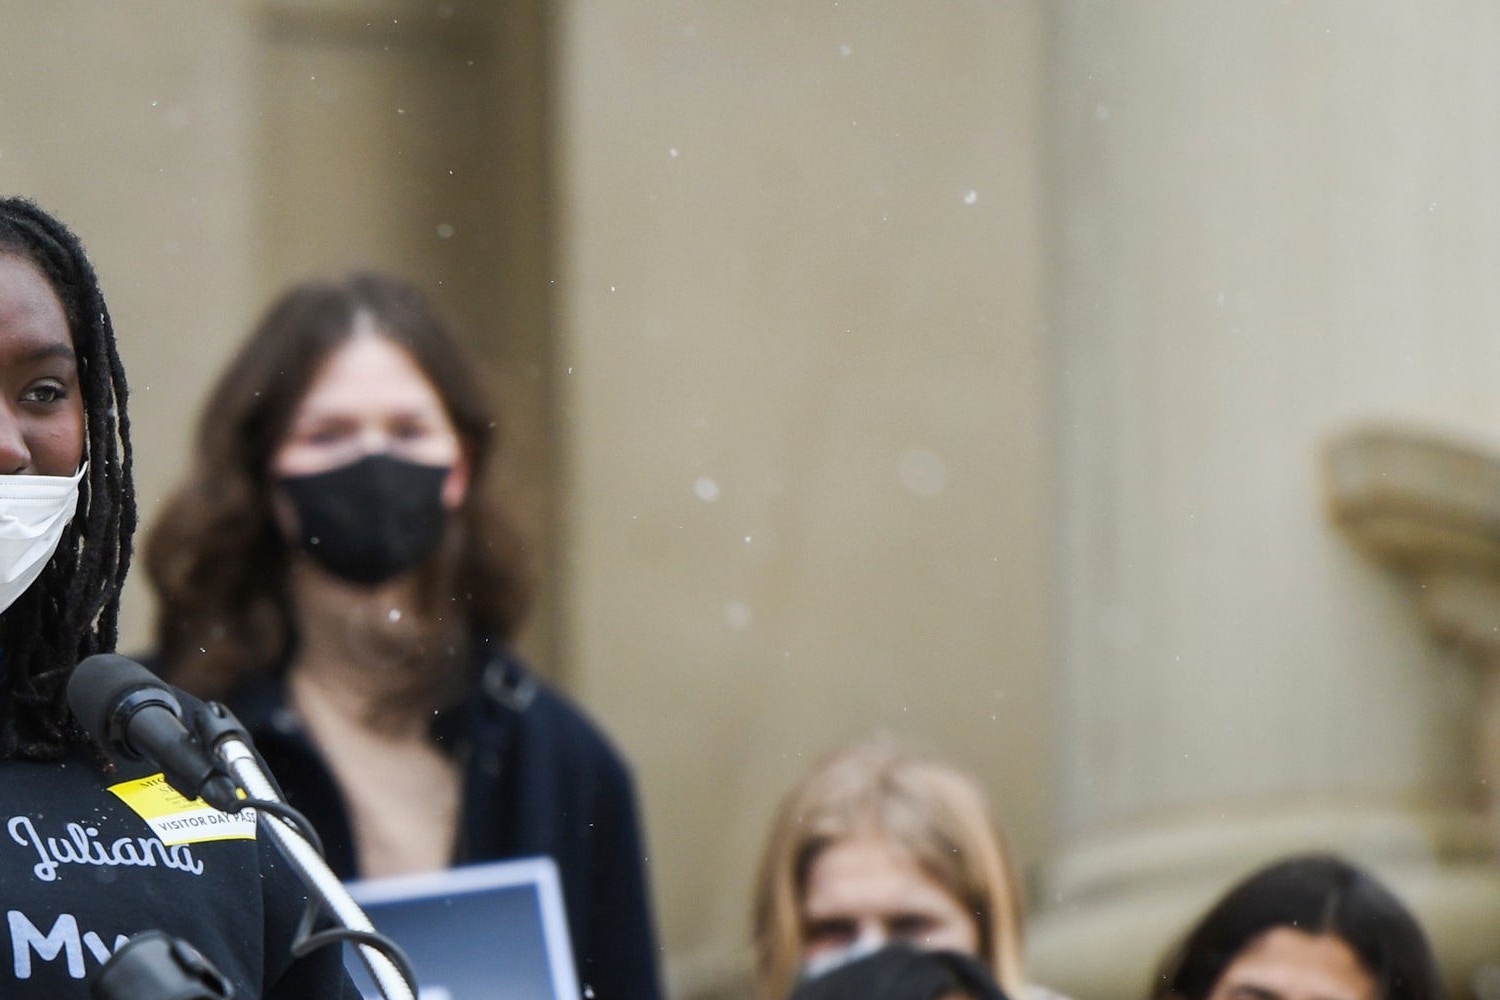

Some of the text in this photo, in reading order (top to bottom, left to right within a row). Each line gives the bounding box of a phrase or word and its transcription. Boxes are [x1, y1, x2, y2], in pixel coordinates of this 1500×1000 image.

[158, 811, 256, 832] VISITOR DAY PASS
[7, 815, 204, 882] Juliana
